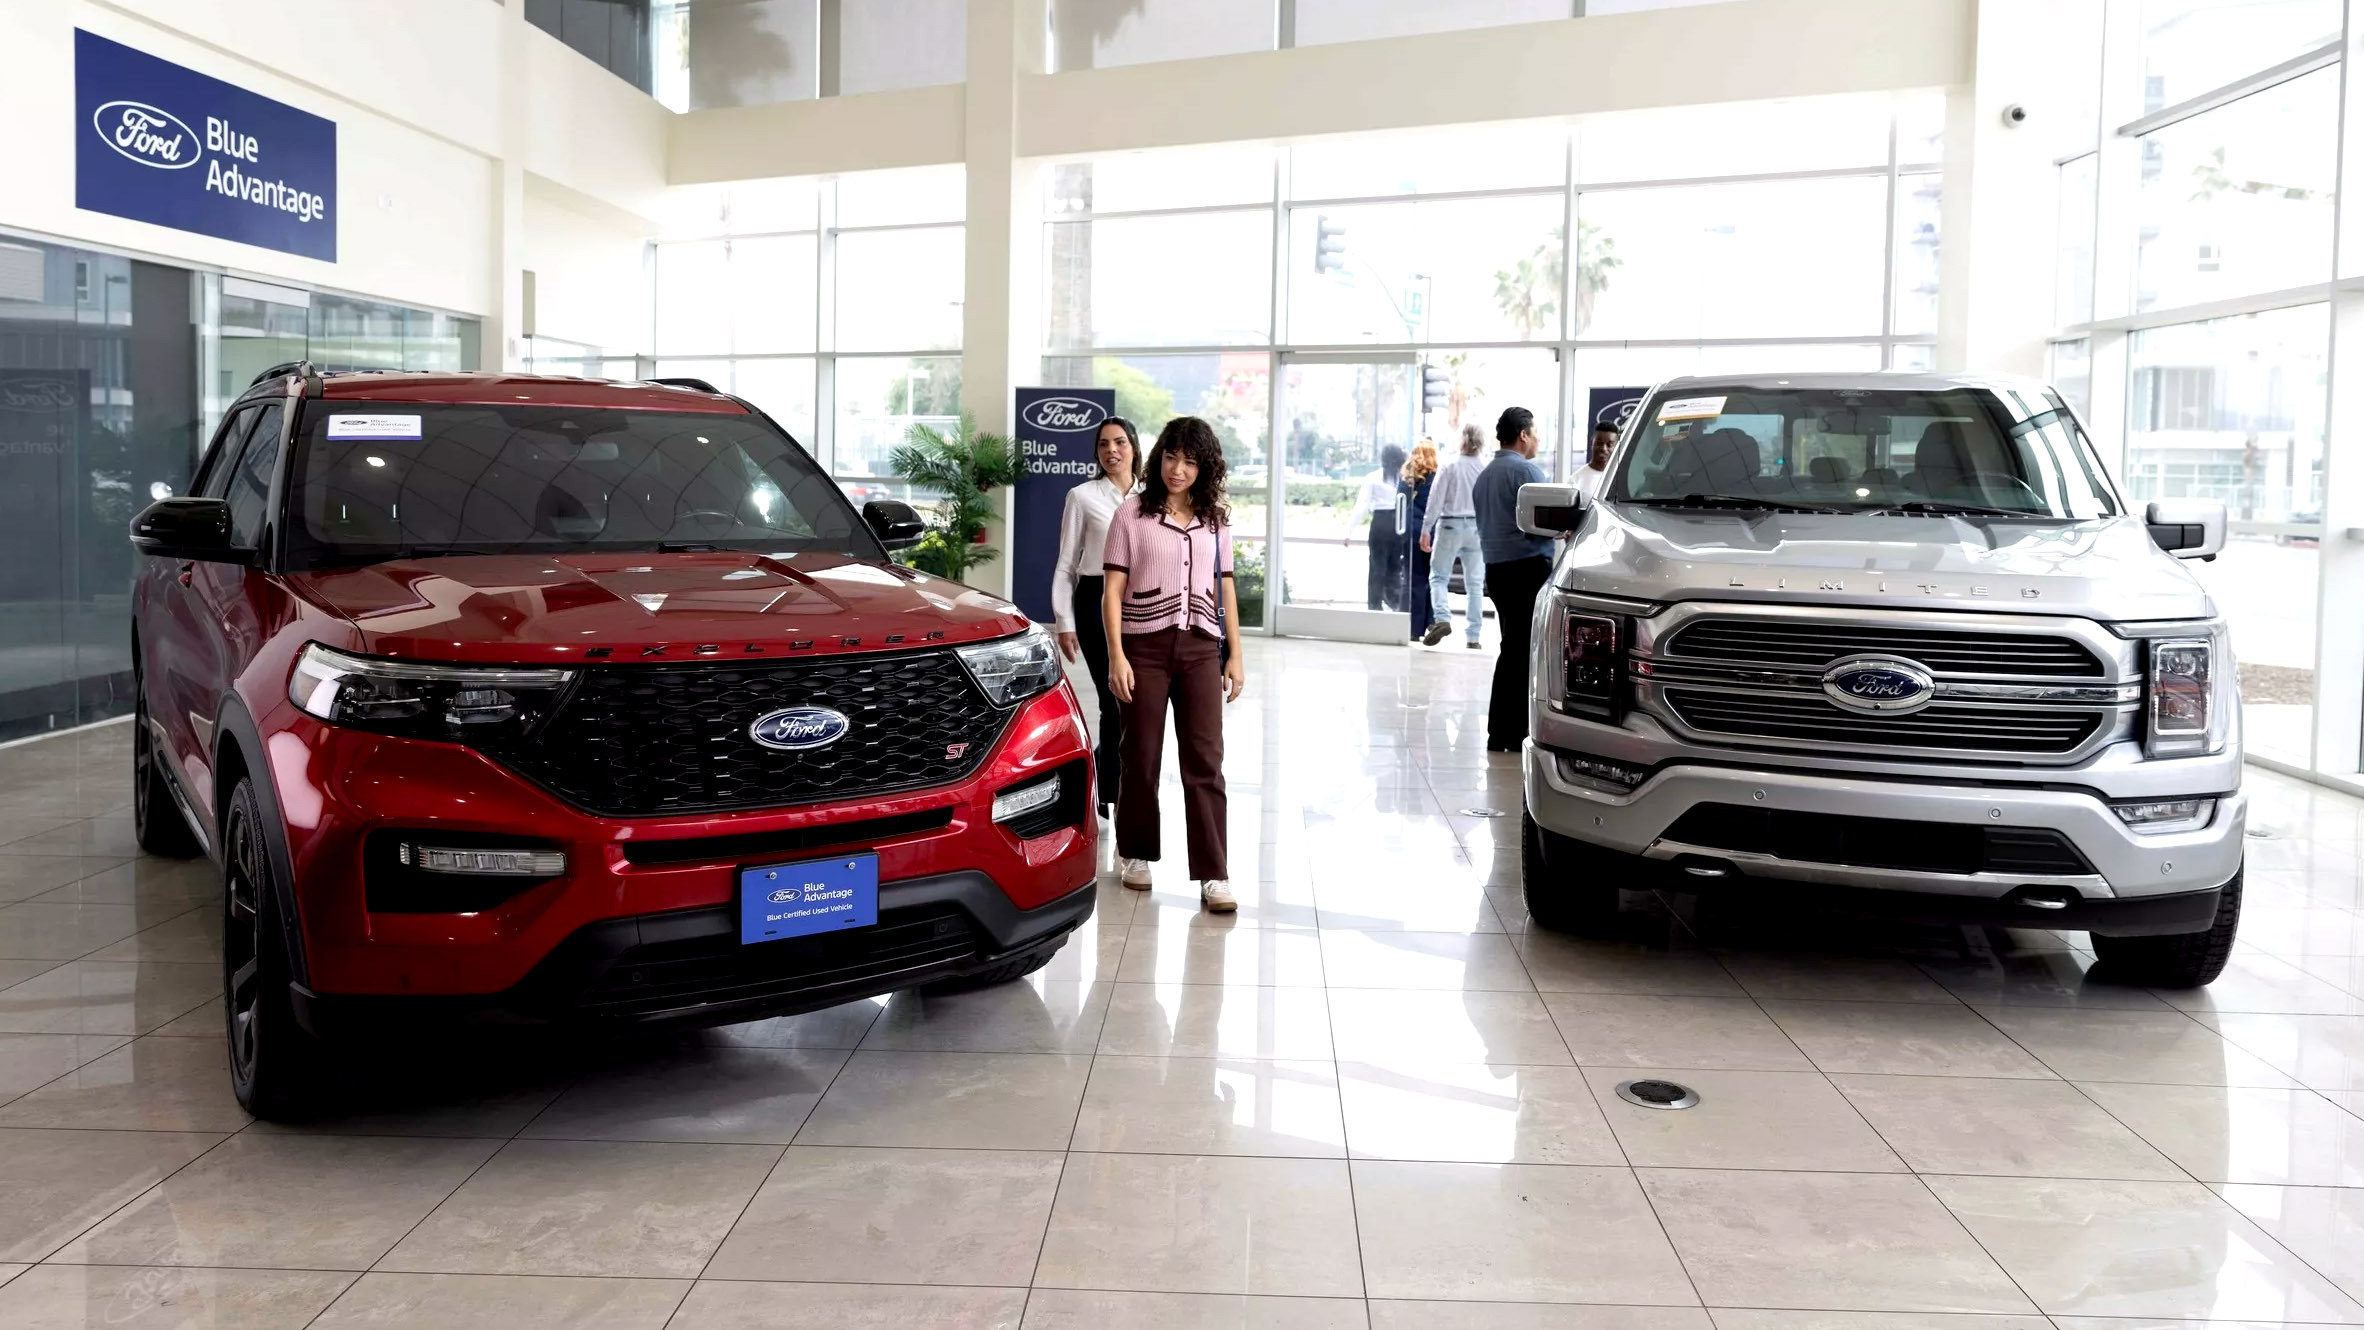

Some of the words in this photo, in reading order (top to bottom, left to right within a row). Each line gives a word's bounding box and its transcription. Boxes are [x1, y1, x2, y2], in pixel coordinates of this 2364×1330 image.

[115, 107, 182, 161] Ford
[206, 116, 259, 163] Blue
[206, 159, 324, 222] Advantage
[1037, 401, 1092, 426] Ford
[1022, 440, 1057, 455] Blue
[1023, 458, 1098, 478] Advantag
[1728, 576, 2042, 599] LIMITED
[584, 631, 945, 658] EXPLORER
[1852, 673, 1904, 696] Ford
[775, 715, 827, 740] Ford
[945, 742, 969, 760] ST
[773, 890, 796, 901] Ford
[803, 888, 853, 903] Advantage
[804, 882, 825, 893] Blue
[767, 913, 782, 922] Blue
[783, 909, 811, 919] Certified
[812, 906, 829, 915] Used
[830, 903, 853, 912] Vehicle
